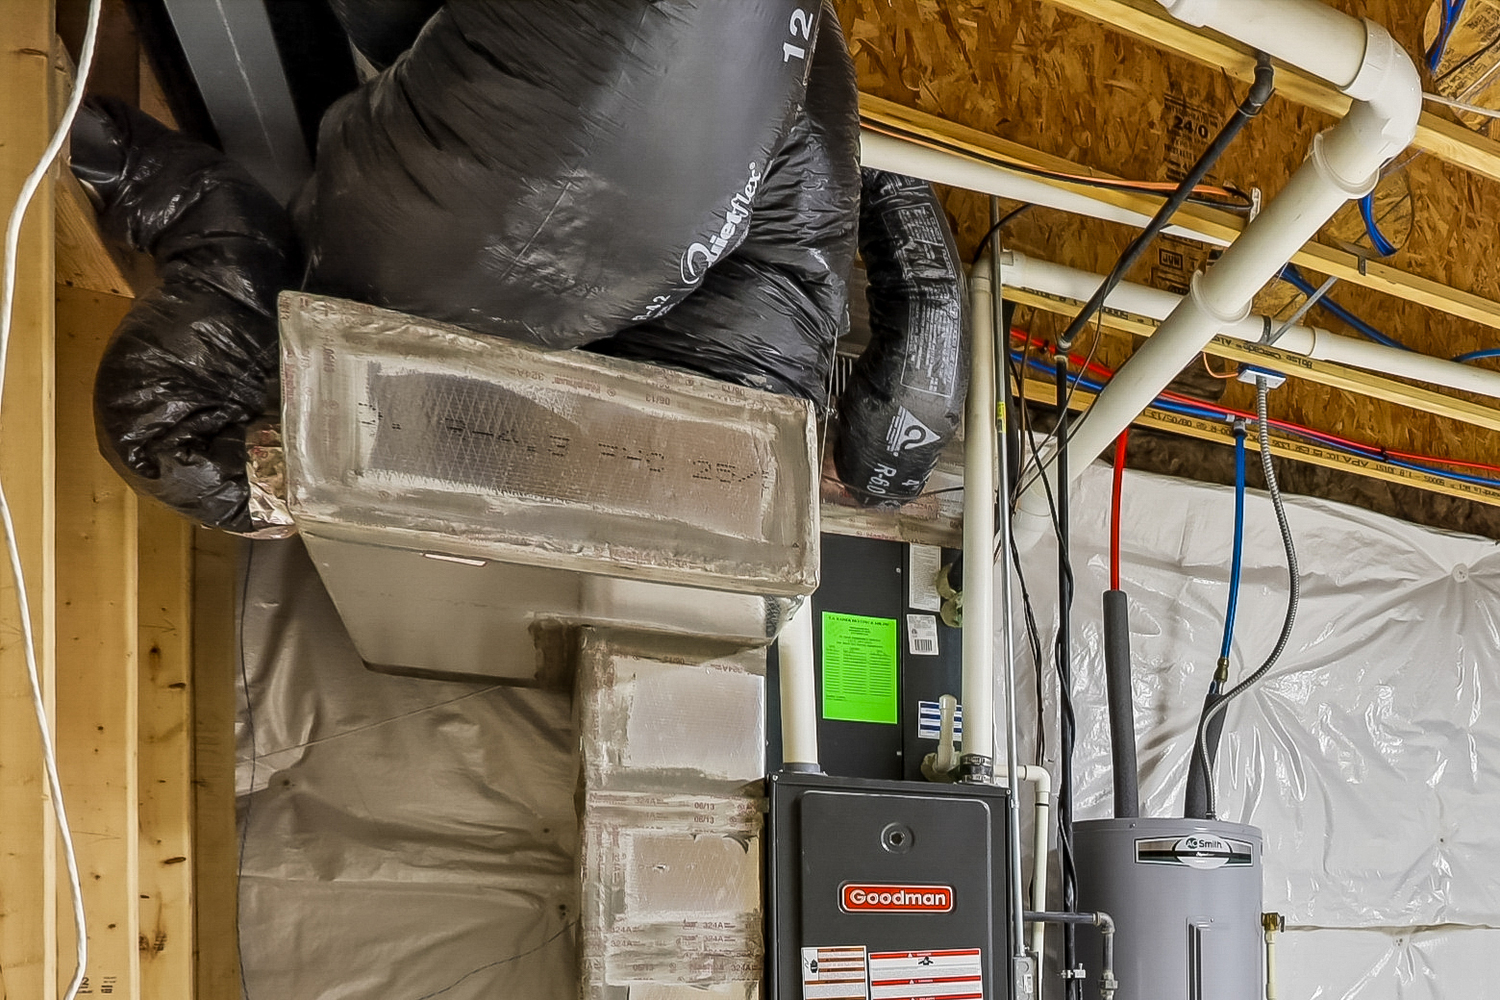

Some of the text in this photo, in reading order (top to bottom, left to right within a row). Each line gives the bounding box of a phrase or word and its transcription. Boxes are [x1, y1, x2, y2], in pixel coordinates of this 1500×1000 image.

[783, 8, 814, 63] 12
[1173, 115, 1209, 139] 24/0
[1285, 354, 1313, 369] Boise
[1343, 456, 1369, 468] APA
[867, 462, 897, 494] R-6.0
[849, 889, 946, 906] Goodman
